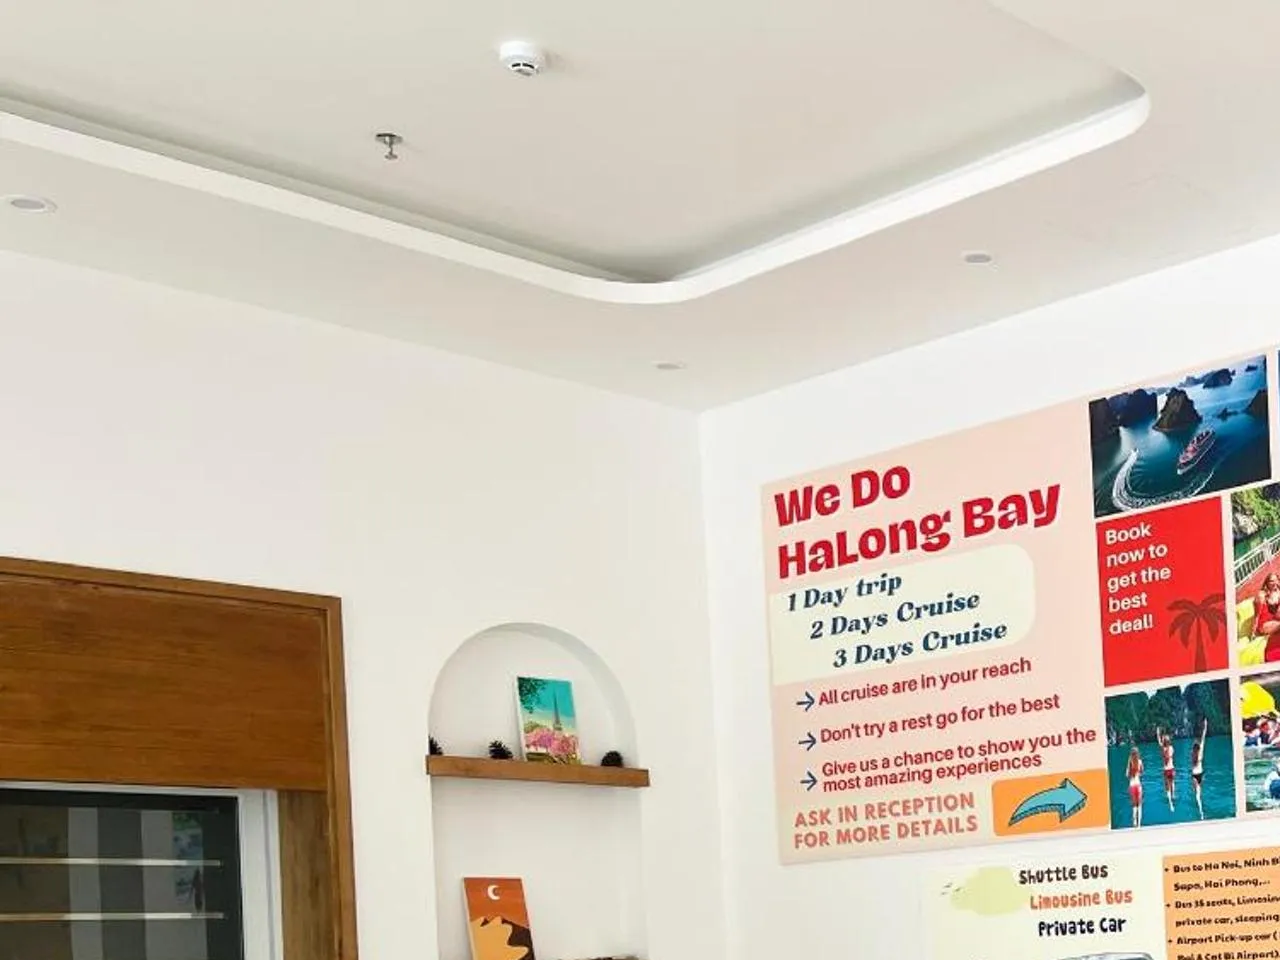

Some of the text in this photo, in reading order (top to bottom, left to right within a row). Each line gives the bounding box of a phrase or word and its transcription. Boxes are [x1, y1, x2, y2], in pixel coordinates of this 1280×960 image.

[774, 465, 911, 526] We Do
[778, 484, 1061, 579] HaLong Bay
[1106, 523, 1152, 545] Book
[1106, 543, 1168, 568] now to
[788, 573, 902, 611] 1 Day trip
[1108, 564, 1171, 593] get the
[810, 593, 980, 639] 2 Days Cruise
[1109, 593, 1148, 613] best
[1109, 613, 1153, 635] deal!
[833, 623, 1007, 667] 3 Days Cruise
[818, 656, 1032, 706] All cruise are in your reach
[820, 694, 1060, 743] Don't try a rest go for the best
[822, 727, 1097, 777] Give us a chance to show you the
[823, 754, 1042, 793] most amazing experiences
[794, 792, 975, 828] ASK IN RECEPTION
[794, 816, 978, 849] FOR MORE DETAILS
[1019, 865, 1077, 885] Shuttle
[1174, 865, 1190, 873] Bus
[1244, 858, 1270, 867] Ninh
[1205, 879, 1223, 888] Hai
[1030, 889, 1133, 910] Limousine Bus
[1175, 900, 1192, 908] Bus
[1038, 916, 1126, 937] Private Car
[1175, 918, 1212, 927] private
[1235, 913, 1280, 923] sleeping
[1177, 935, 1213, 945] Airport
